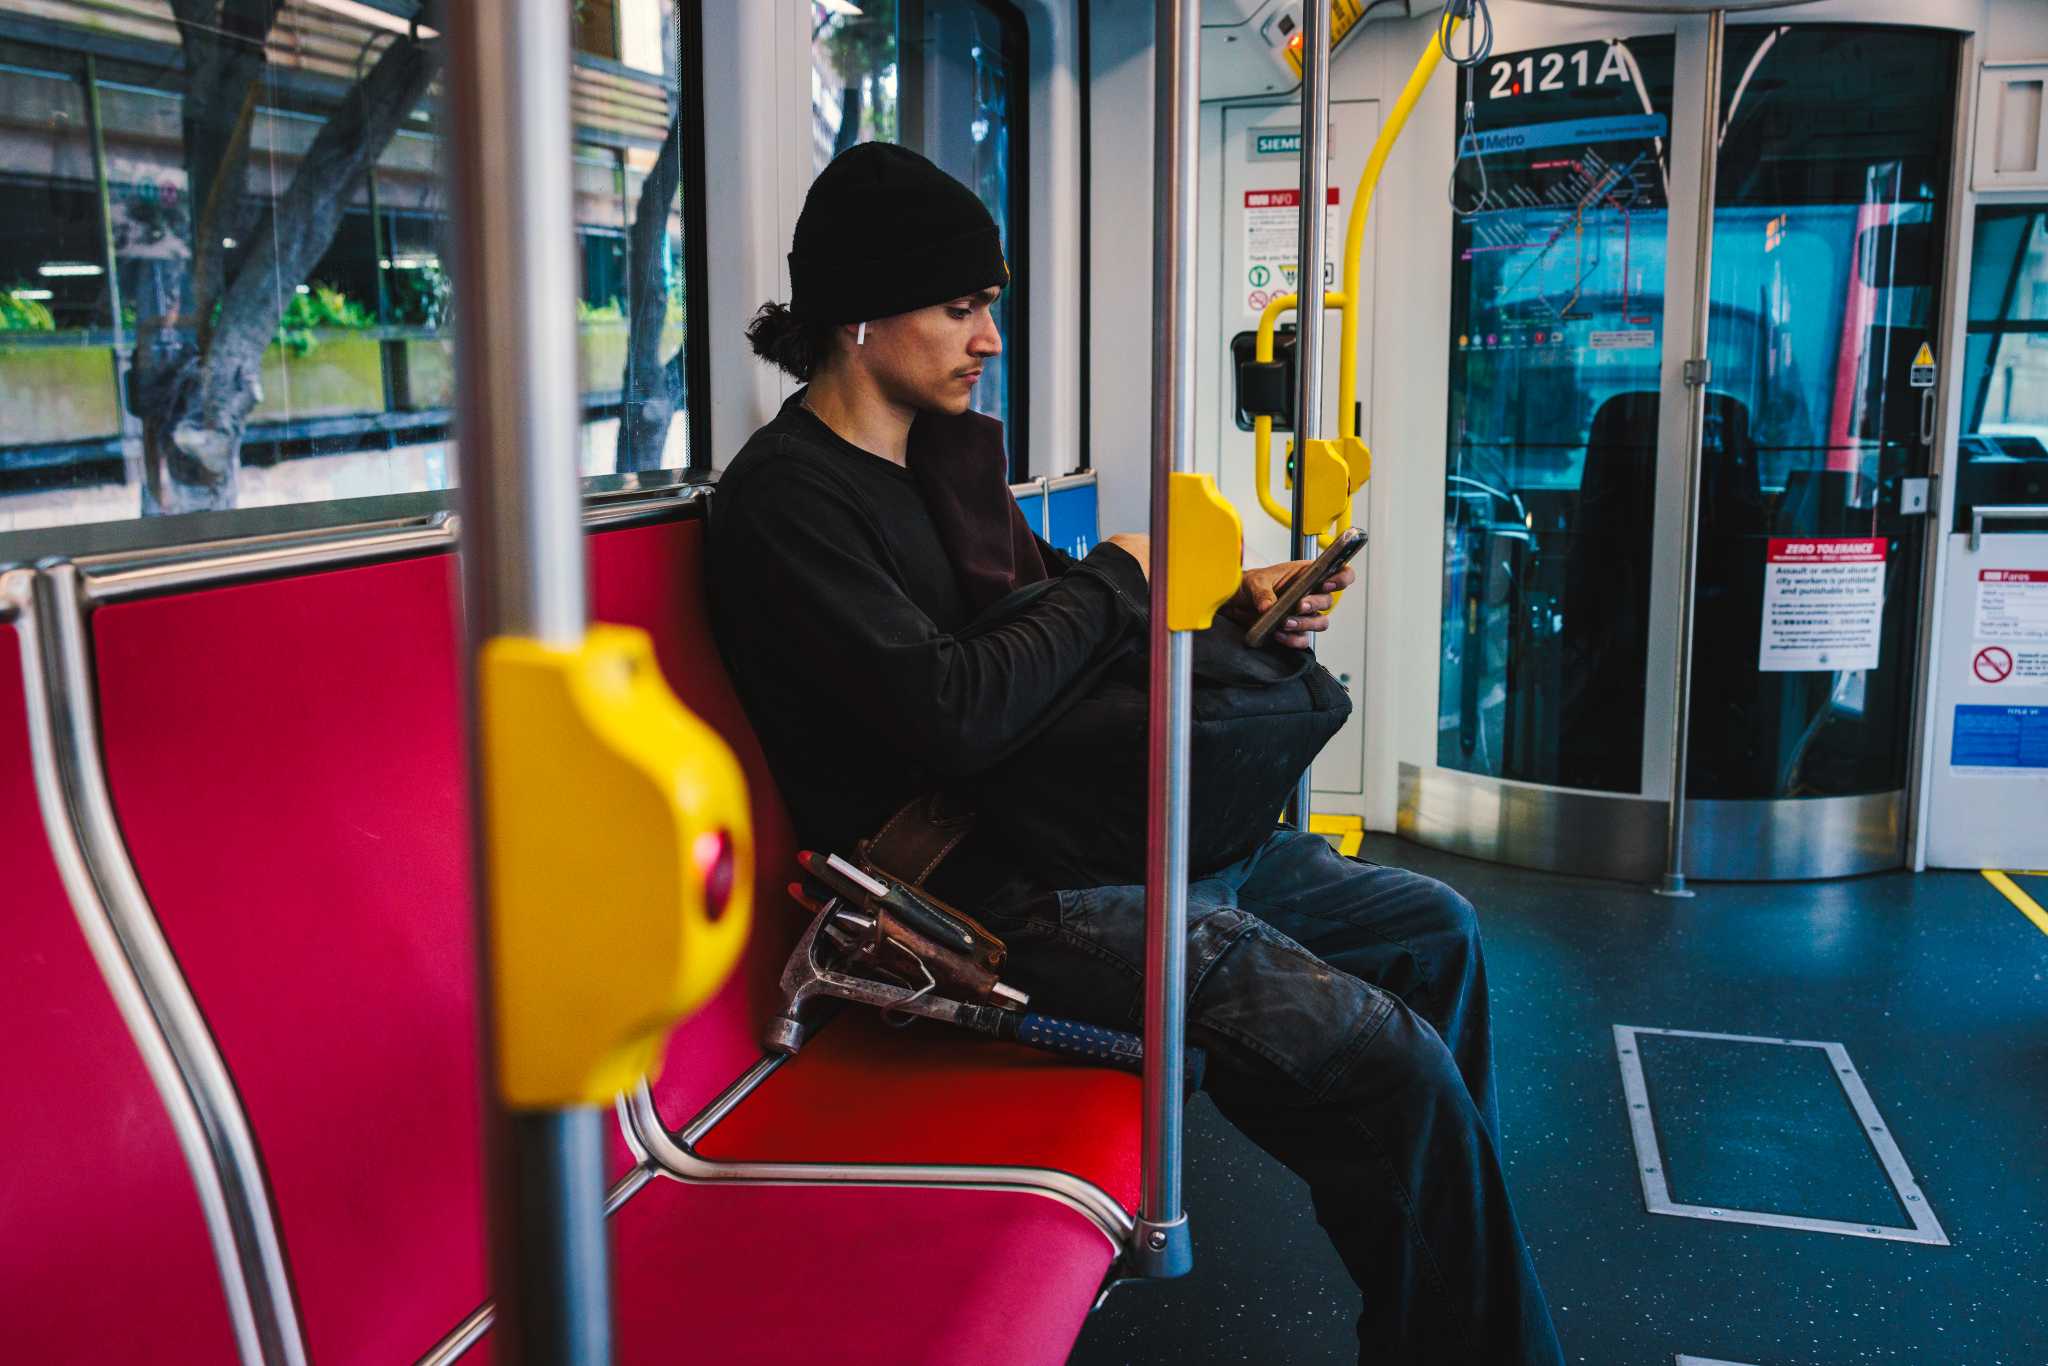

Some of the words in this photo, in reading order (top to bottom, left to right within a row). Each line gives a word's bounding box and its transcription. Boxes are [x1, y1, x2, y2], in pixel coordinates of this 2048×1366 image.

[1490, 46, 1630, 99] 2121A
[1260, 138, 1301, 150] SIEME
[1485, 134, 1525, 150] Metro
[1785, 543, 1815, 554] ZERO
[1816, 543, 1874, 554] TOLERANCE
[1776, 567, 1807, 575] Assault
[2003, 571, 2030, 582] Fares
[1799, 587, 1843, 596] punishable
